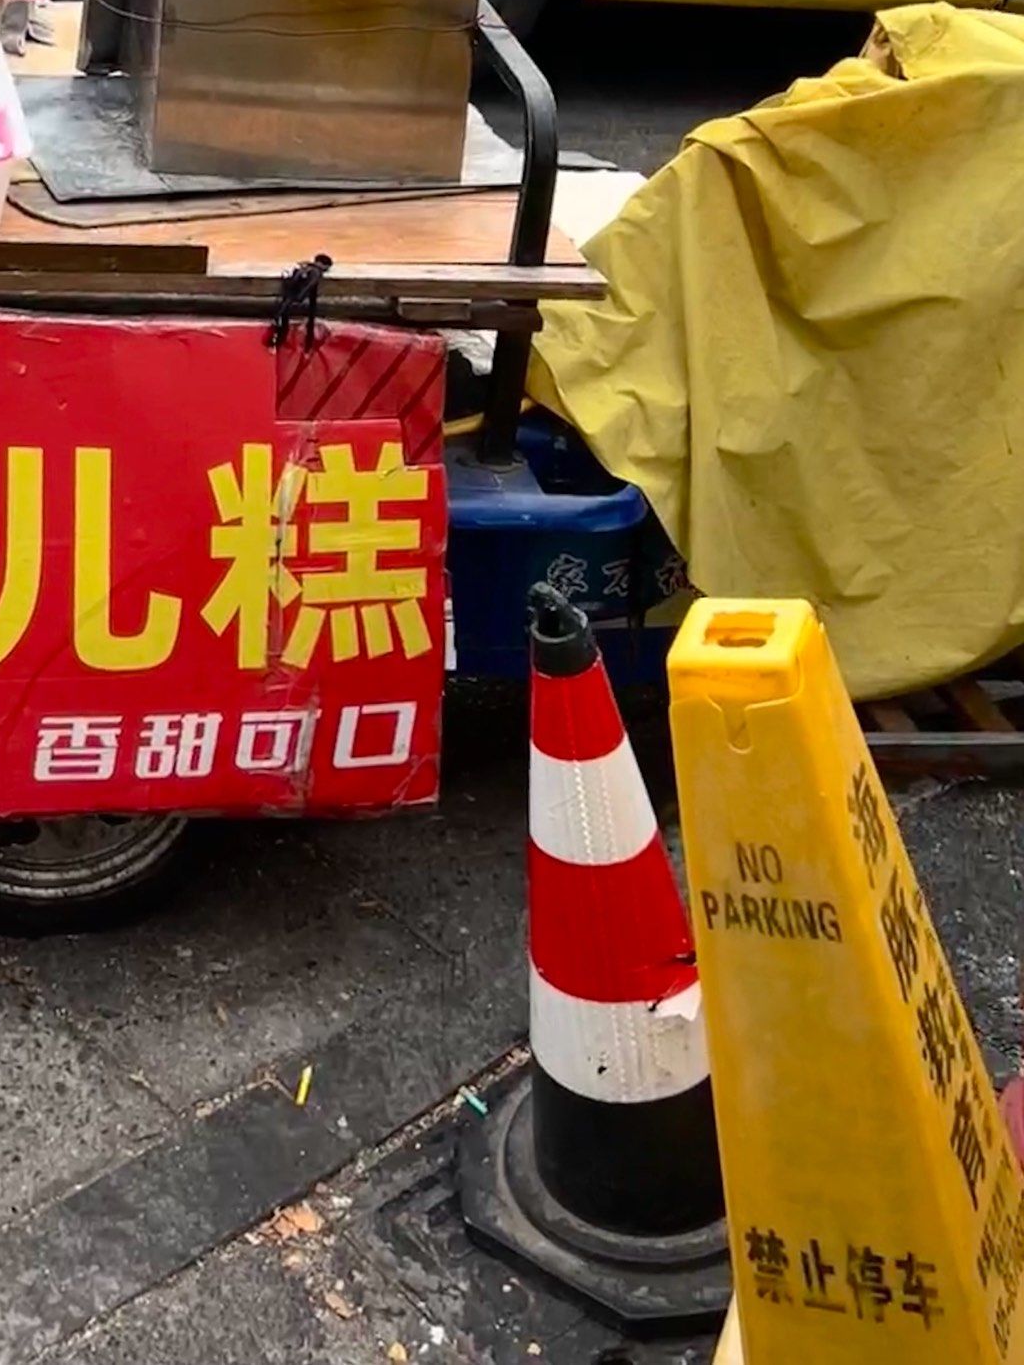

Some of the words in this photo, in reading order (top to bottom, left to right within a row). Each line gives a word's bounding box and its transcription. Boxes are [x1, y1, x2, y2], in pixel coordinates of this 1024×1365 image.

[33, 701, 417, 781] 香甜可口
[735, 841, 783, 884] NO
[701, 890, 842, 943] PARKING
[745, 1226, 945, 1331] 禁止停车
